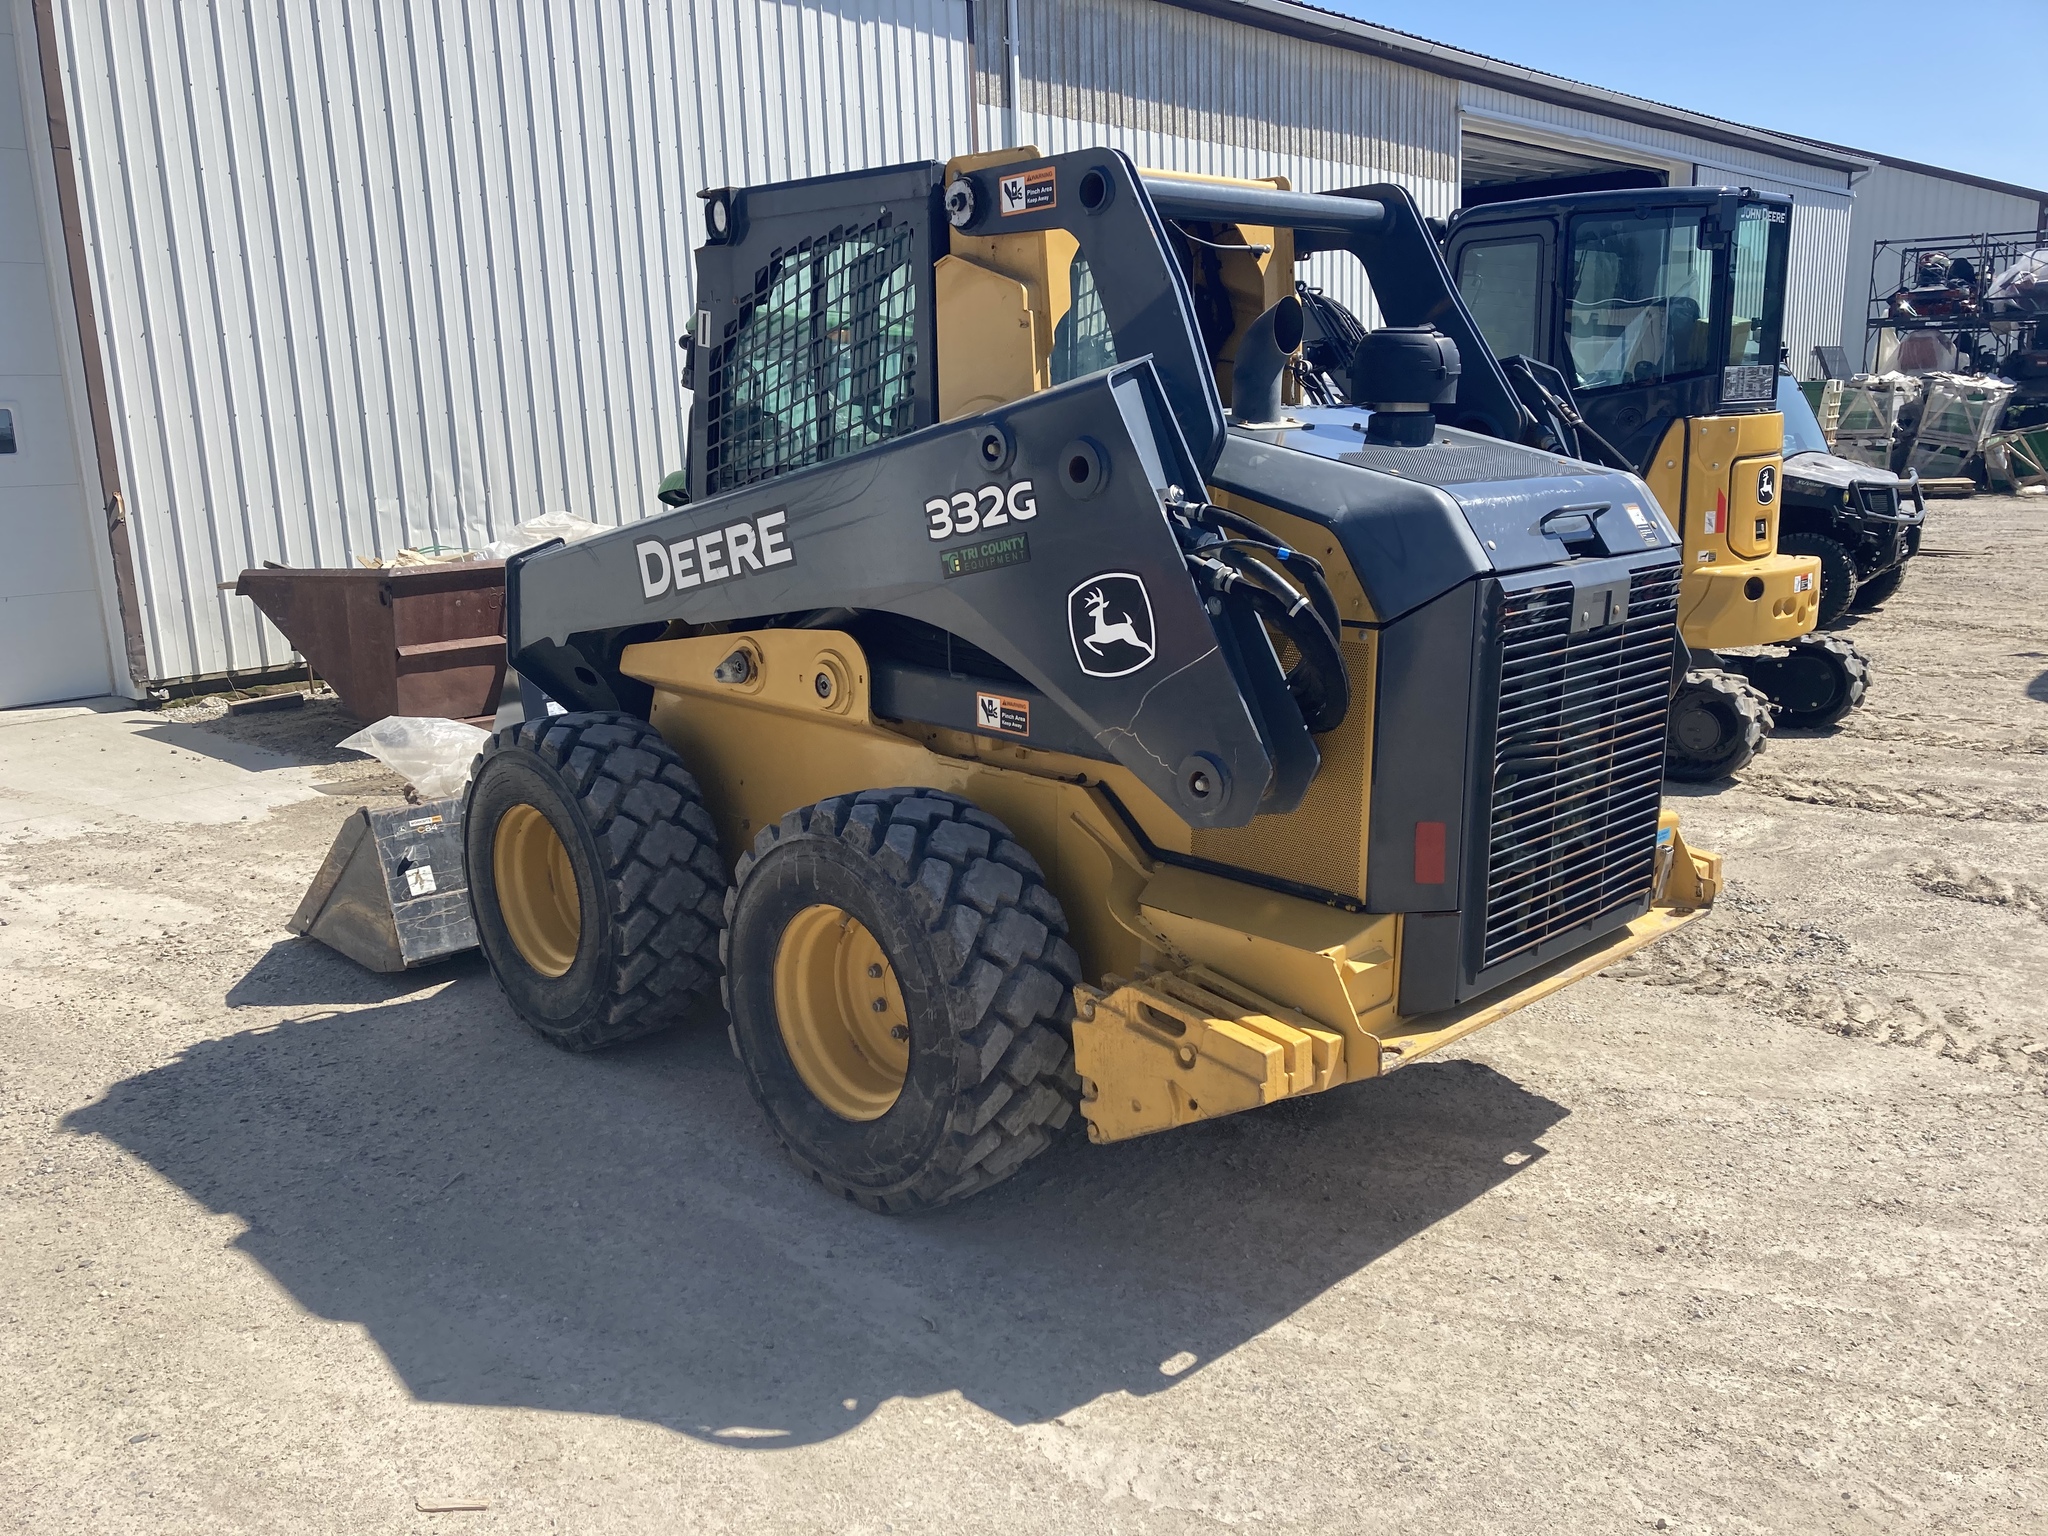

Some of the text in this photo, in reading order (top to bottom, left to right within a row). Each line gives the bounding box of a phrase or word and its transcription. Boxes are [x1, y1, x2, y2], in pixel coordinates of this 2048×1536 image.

[1040, 186, 1053, 194] Area
[1741, 206, 1786, 223] JOHN DEERE
[925, 481, 1037, 539] 332G
[636, 510, 793, 598] DEERE
[961, 536, 1025, 560] TRI COUNTY
[964, 550, 1025, 571] EQUIPMENT
